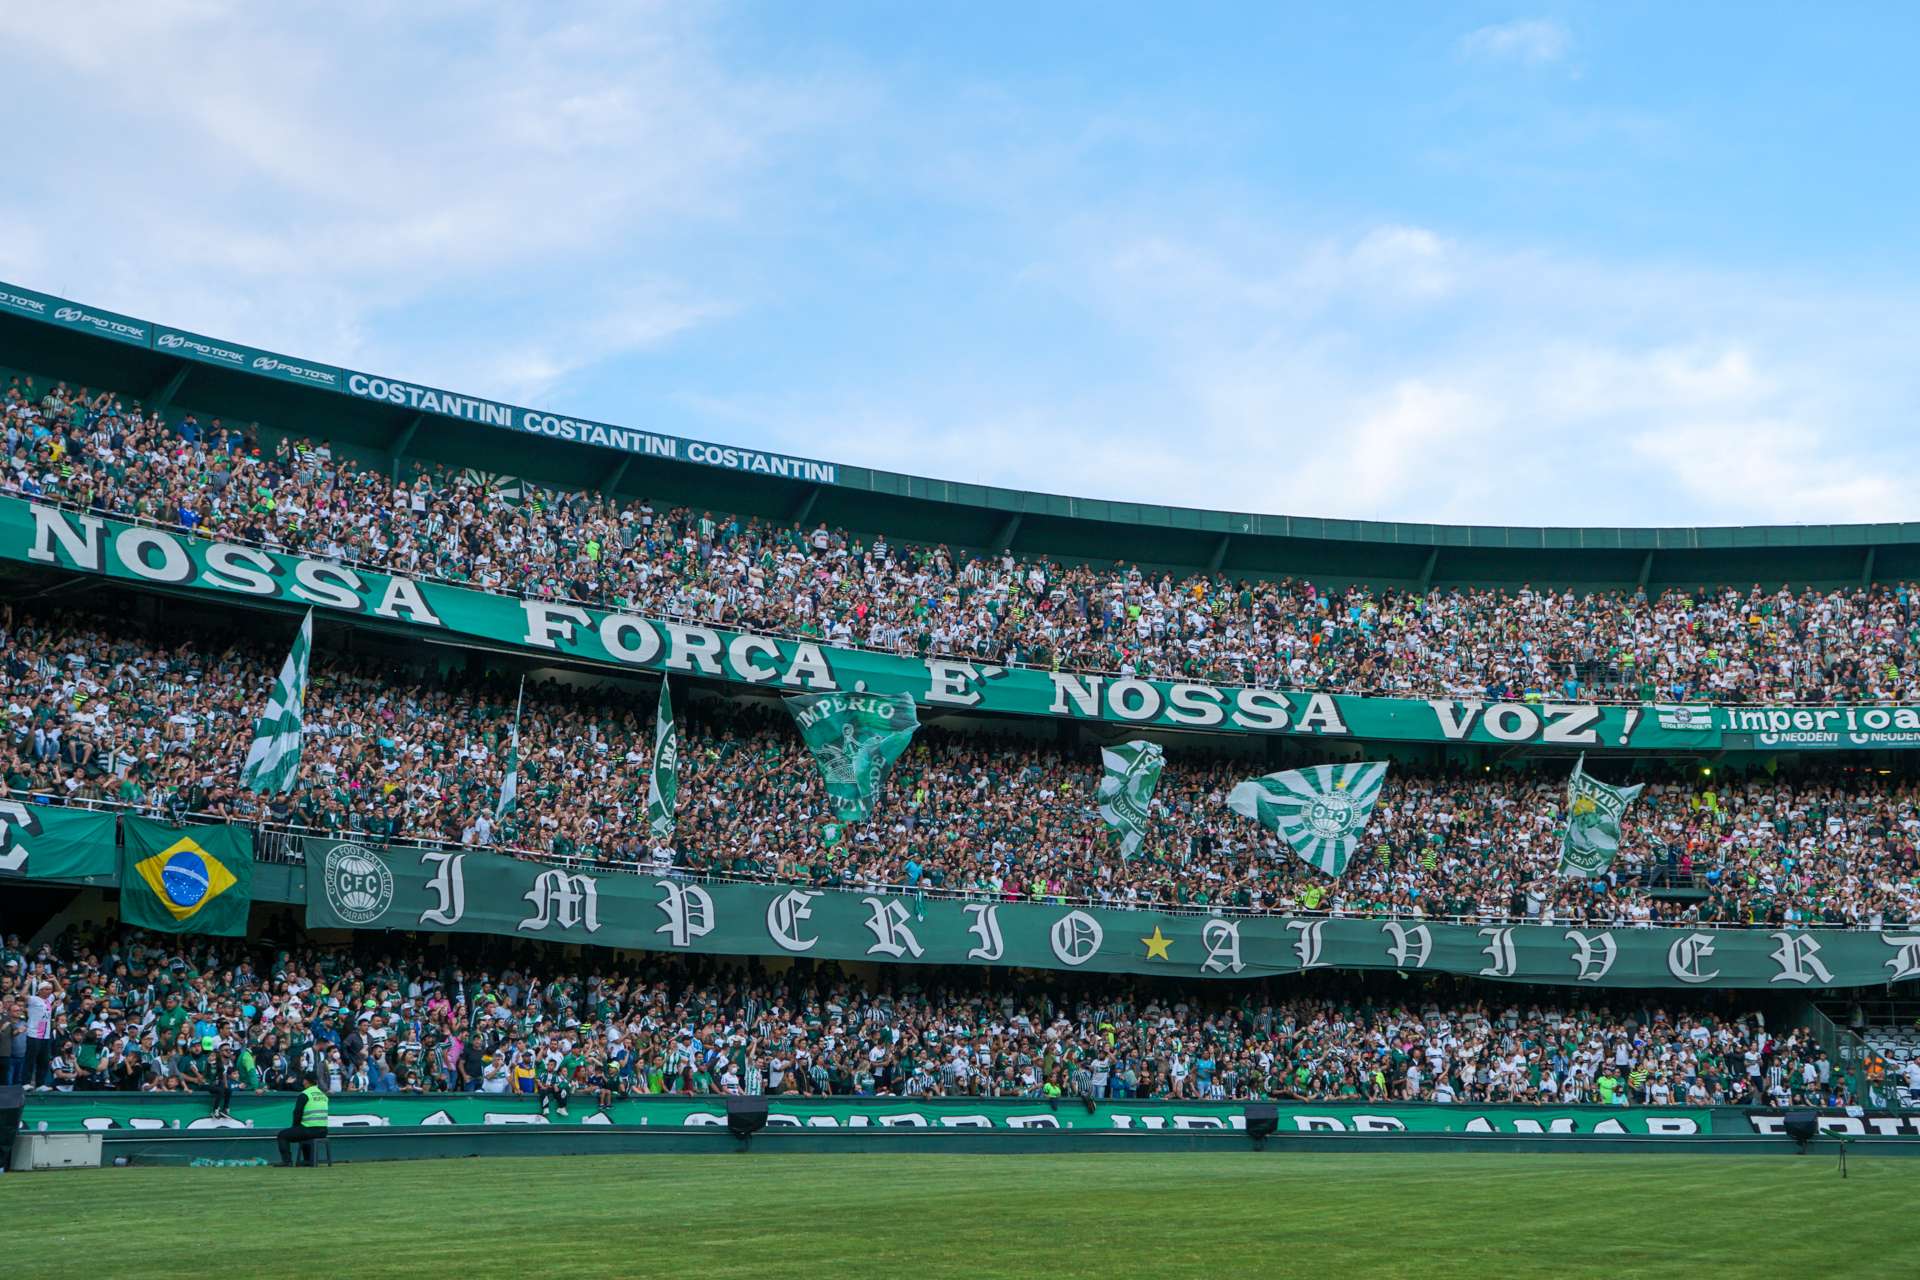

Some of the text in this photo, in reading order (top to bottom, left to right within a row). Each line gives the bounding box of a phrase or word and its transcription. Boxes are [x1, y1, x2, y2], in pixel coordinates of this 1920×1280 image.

[10, 294, 47, 311] TORK
[81, 315, 110, 328] PRO
[110, 321, 145, 337] TORK
[183, 340, 211, 354] PRO
[211, 347, 246, 361] TORK
[277, 363, 303, 375] PRO
[303, 369, 336, 382] TORK
[348, 374, 512, 428] COSTANTINI
[523, 412, 677, 459] COSTANTINI
[687, 442, 836, 484] COSTANTINI
[27, 503, 441, 626] NOSSA
[1049, 671, 1349, 734] NOSSA
[1781, 732, 1839, 742] NEODENT
[339, 846, 361, 857] FOOT
[363, 852, 382, 870] BALL
[382, 871, 392, 898] CLUB
